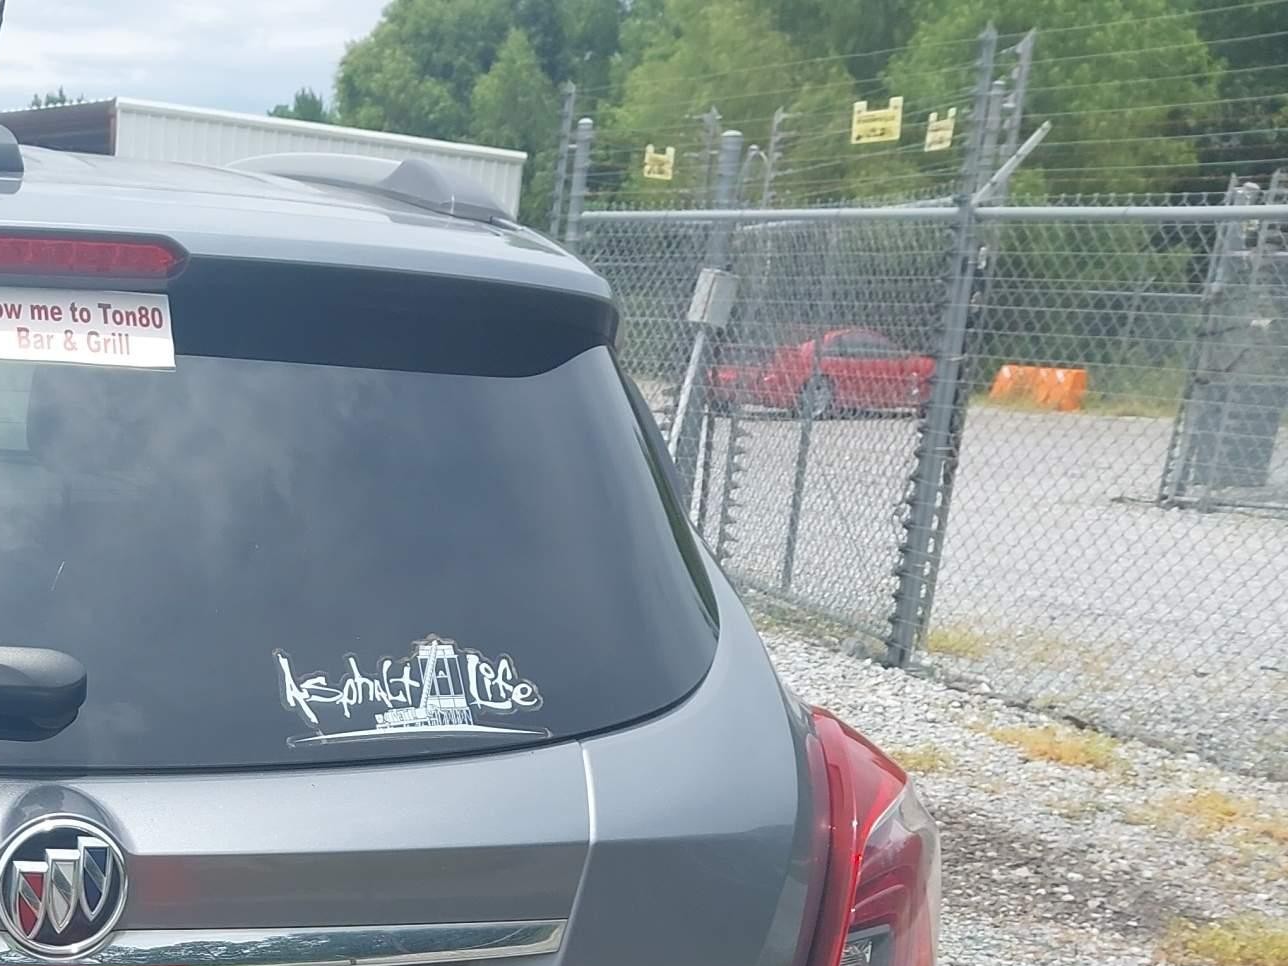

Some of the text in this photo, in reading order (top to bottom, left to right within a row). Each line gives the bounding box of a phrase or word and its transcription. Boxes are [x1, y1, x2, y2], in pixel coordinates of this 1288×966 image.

[30, 304, 63, 322] me
[71, 302, 91, 324] to
[98, 303, 163, 330] Ton80
[16, 327, 131, 356] Bar & Grill
